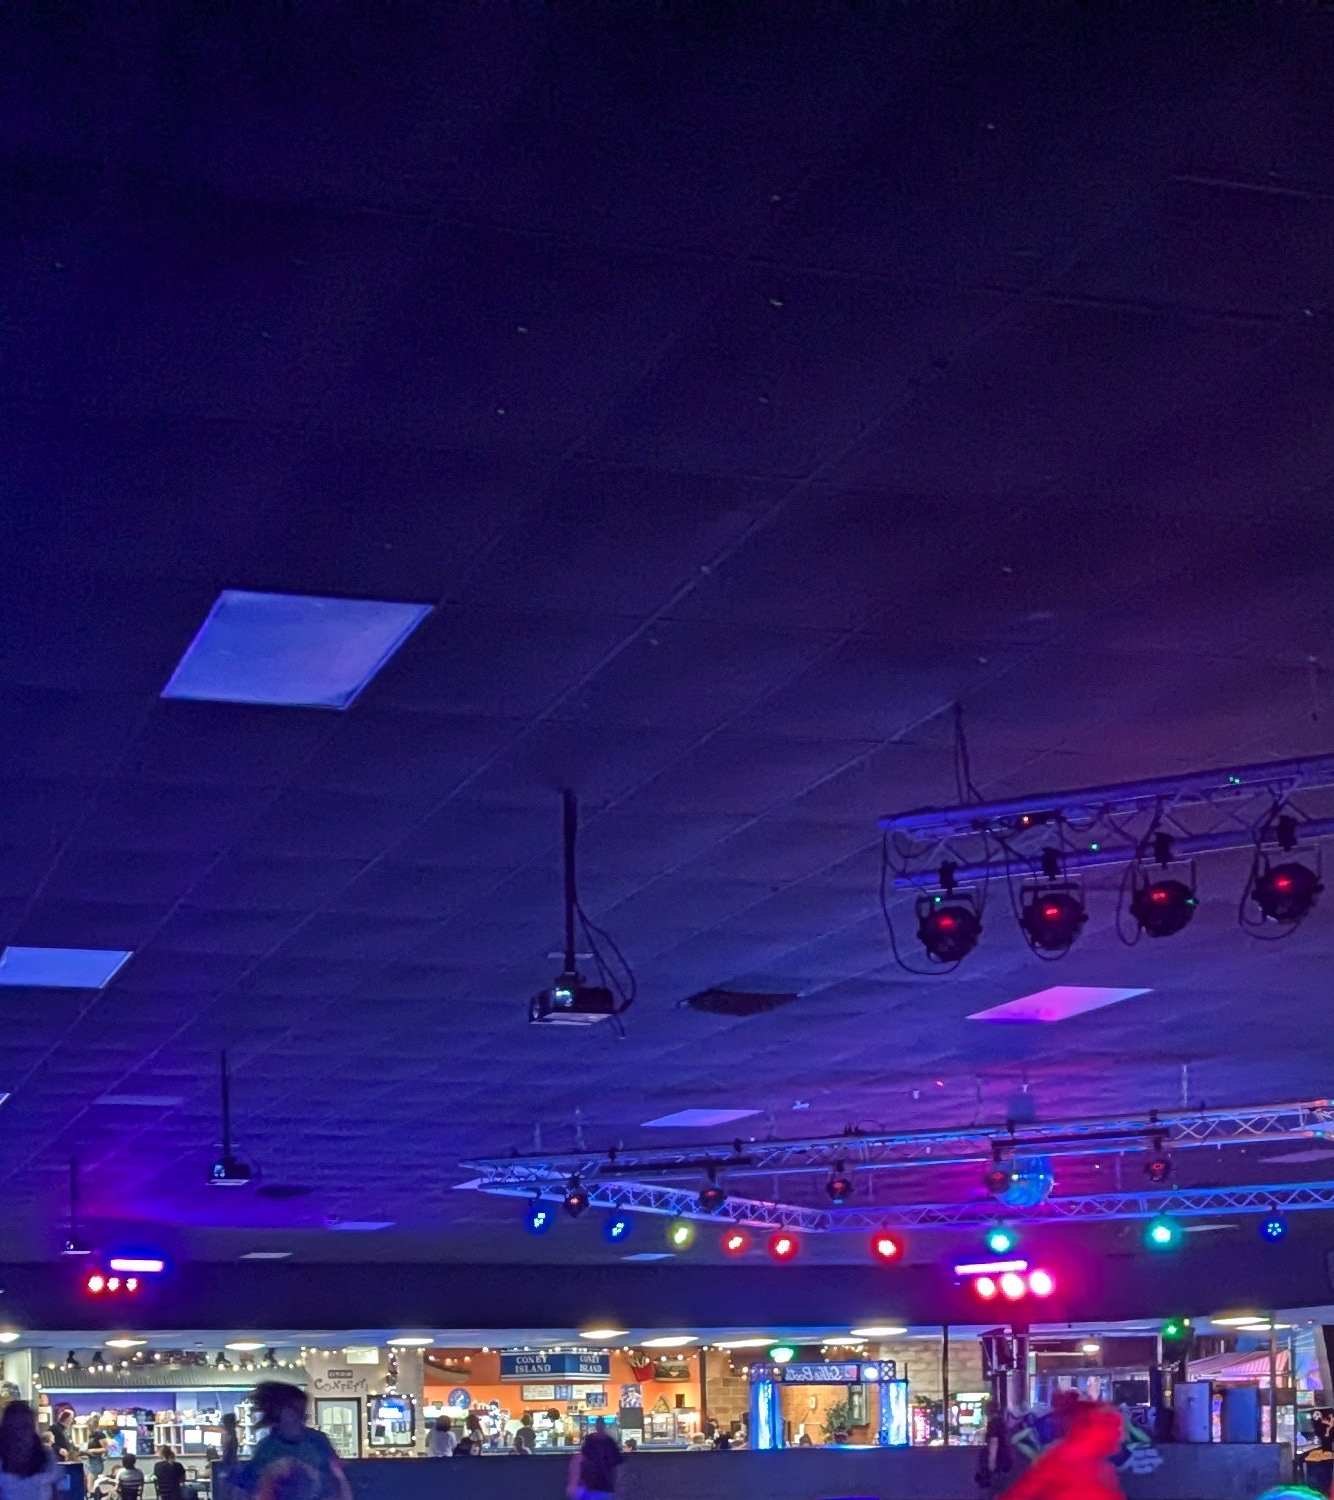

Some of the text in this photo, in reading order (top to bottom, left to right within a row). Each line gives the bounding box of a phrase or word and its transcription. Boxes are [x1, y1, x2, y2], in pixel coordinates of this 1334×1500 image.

[515, 1355, 548, 1364] CONEY
[579, 1355, 600, 1364] CONEY
[514, 1364, 552, 1373] ISLAND
[579, 1363, 603, 1373] ISLAND
